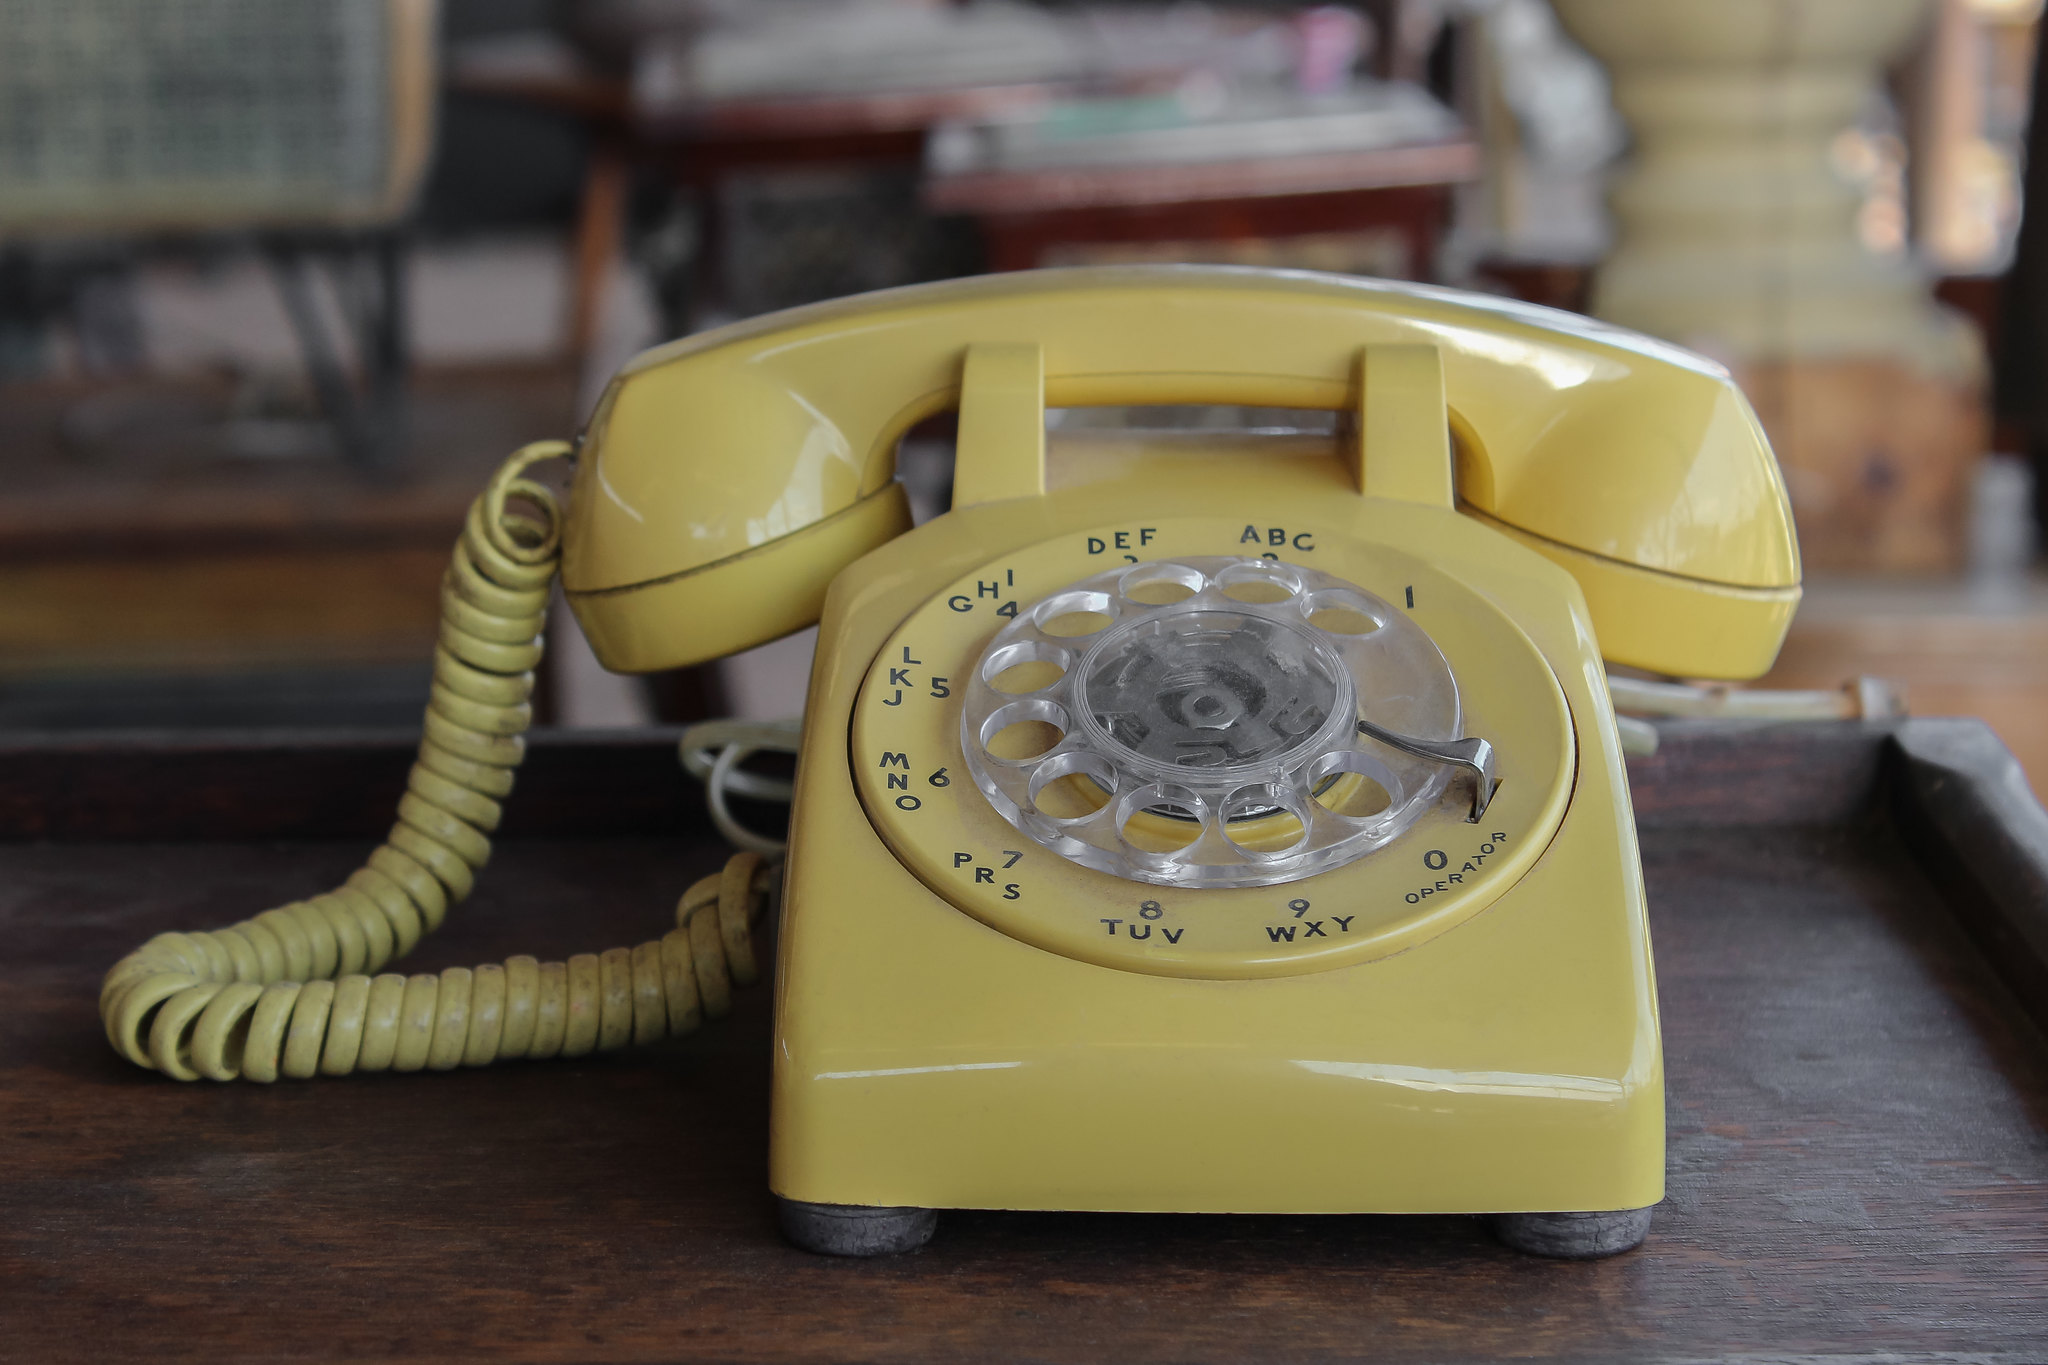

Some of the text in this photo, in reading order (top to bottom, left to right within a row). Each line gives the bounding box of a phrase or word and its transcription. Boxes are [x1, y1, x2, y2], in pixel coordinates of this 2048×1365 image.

[1087, 528, 1157, 554] DEF
[1240, 524, 1315, 551] ABC
[948, 569, 1014, 612] GHI
[996, 601, 1019, 619] 4
[930, 677, 950, 698] 5
[928, 767, 950, 787] 6
[1002, 850, 1024, 869] 7
[1405, 832, 1506, 904] OPERATOR
[953, 852, 1021, 900] PRS
[1139, 900, 1163, 920] 8
[1288, 898, 1310, 918] 9
[1100, 919, 1184, 945] TUV
[1265, 915, 1355, 943] WXY
